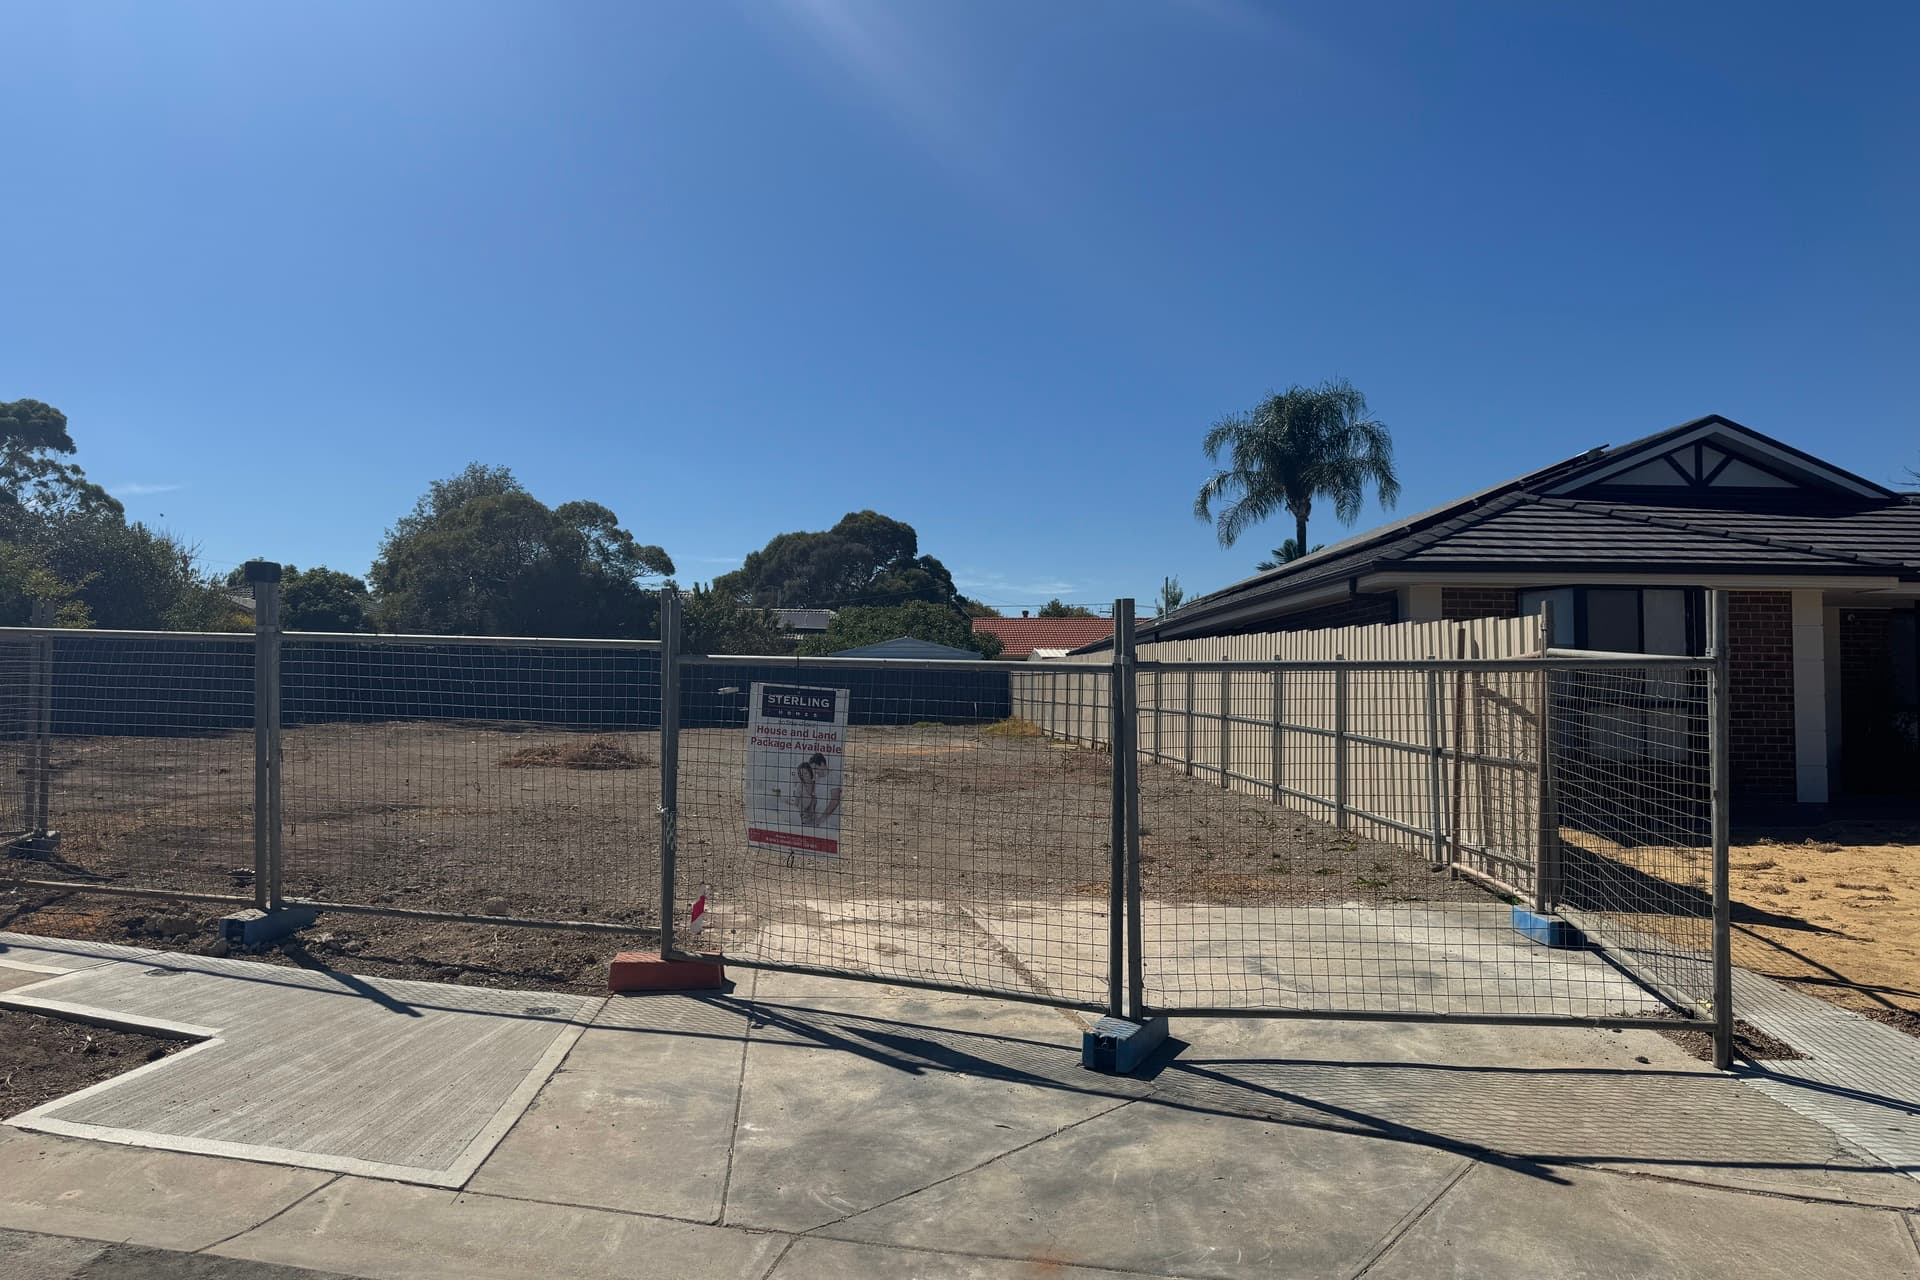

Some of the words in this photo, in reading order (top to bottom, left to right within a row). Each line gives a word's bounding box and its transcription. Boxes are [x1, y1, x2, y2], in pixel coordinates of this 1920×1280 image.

[767, 695, 830, 708] STERLING
[756, 725, 788, 736] House
[790, 728, 809, 738] and
[812, 729, 837, 740] Land
[750, 736, 793, 750] Package
[795, 741, 842, 754] Available
